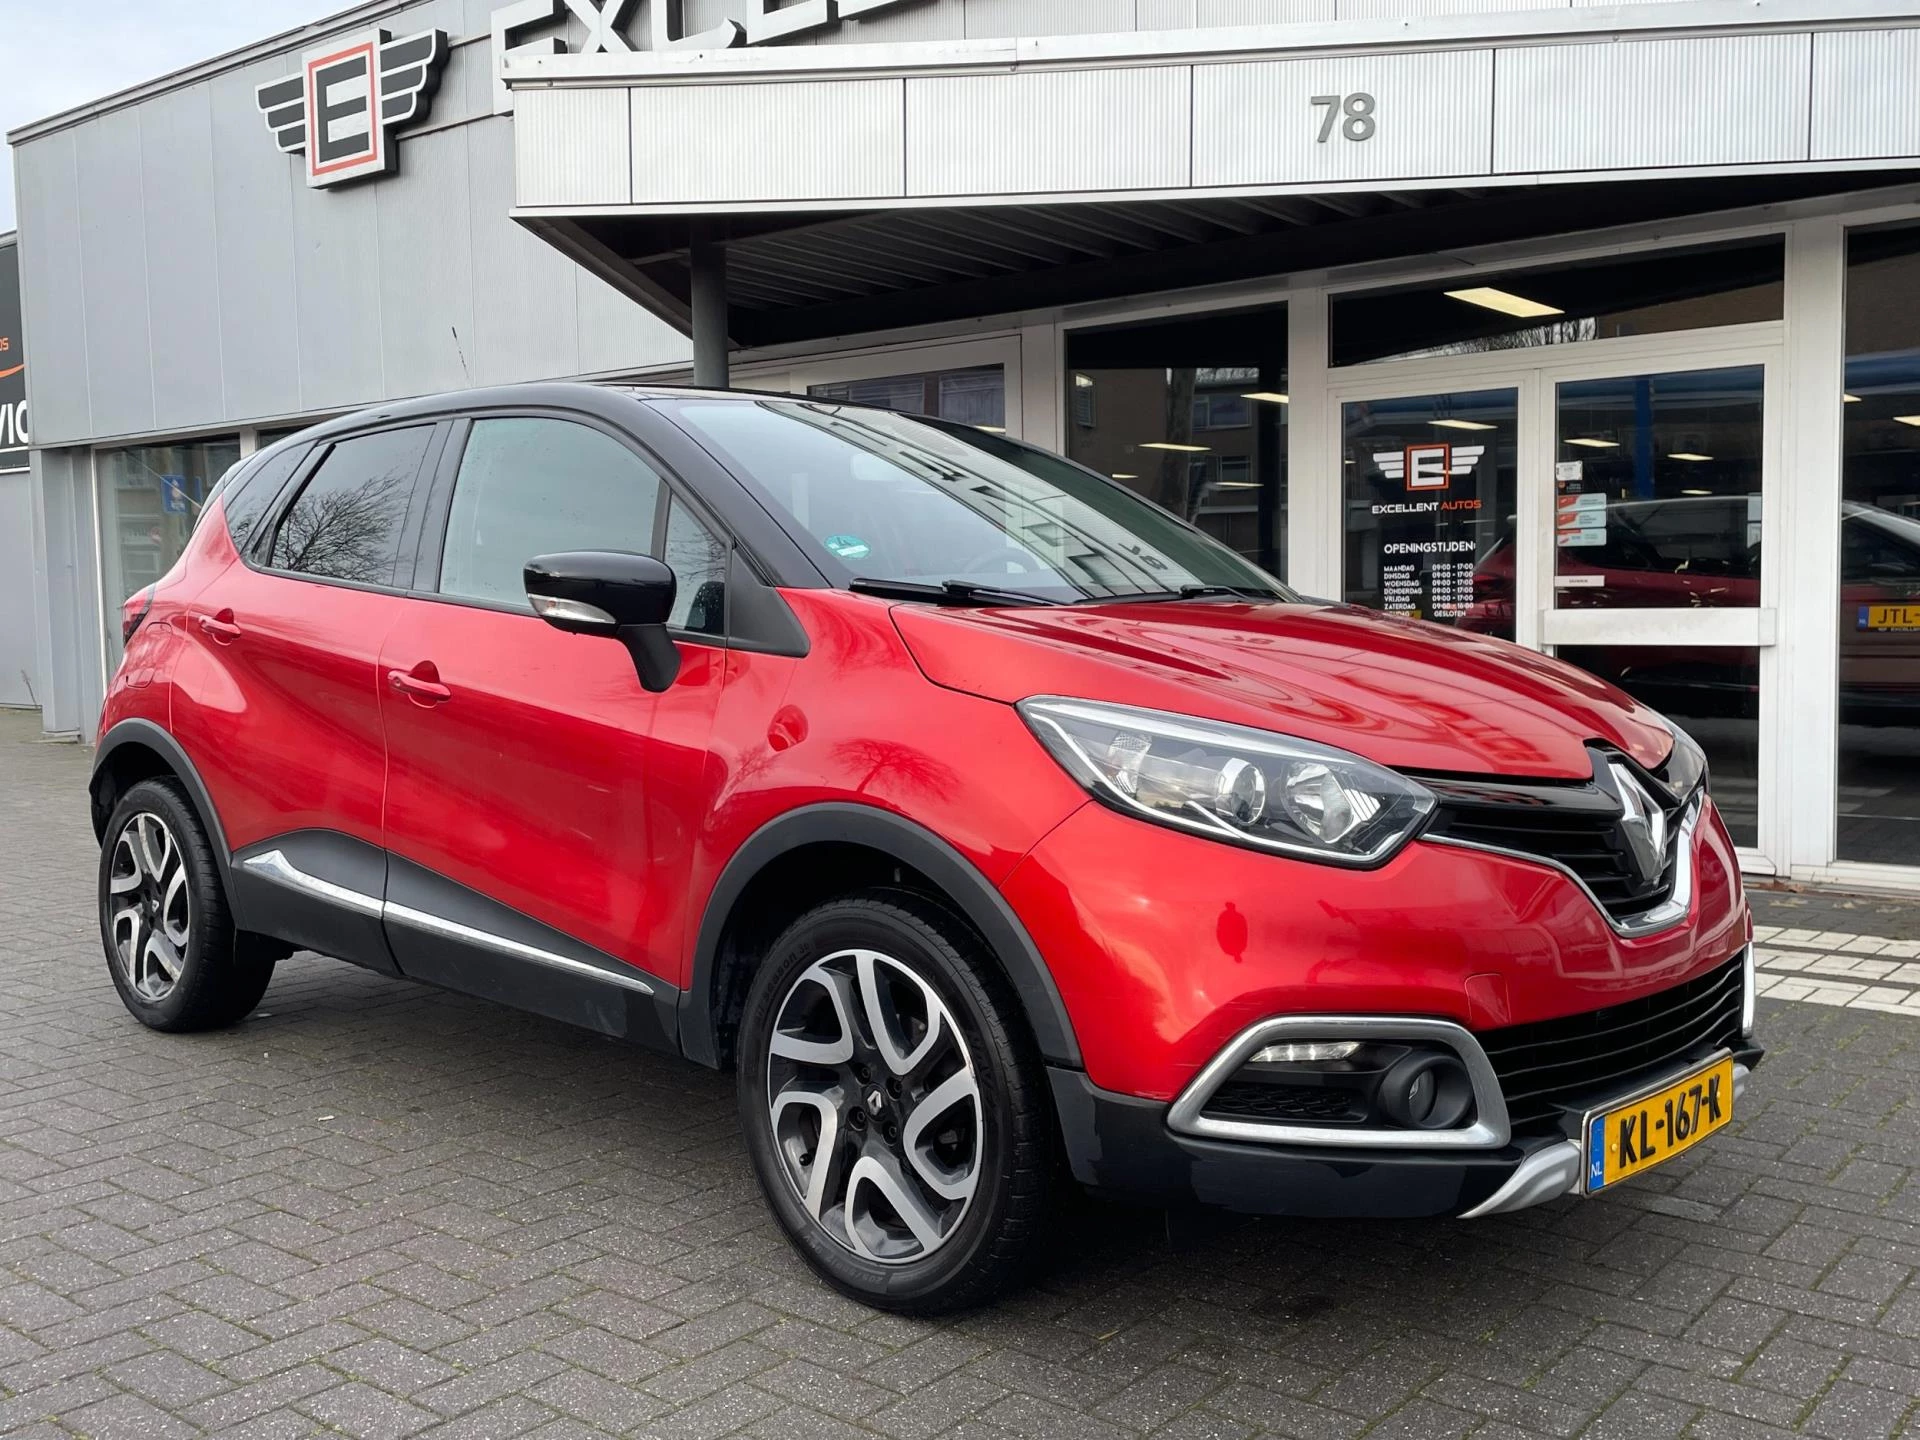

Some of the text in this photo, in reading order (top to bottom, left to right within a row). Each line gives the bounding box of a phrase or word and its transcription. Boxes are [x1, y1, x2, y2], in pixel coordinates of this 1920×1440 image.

[316, 55, 370, 163] E
[1310, 92, 1376, 143] 78
[1371, 499, 1482, 514] EXCELLENT AUTOS
[1619, 1073, 1722, 1169] KL-167-K
[1590, 1160, 1603, 1179] NL
